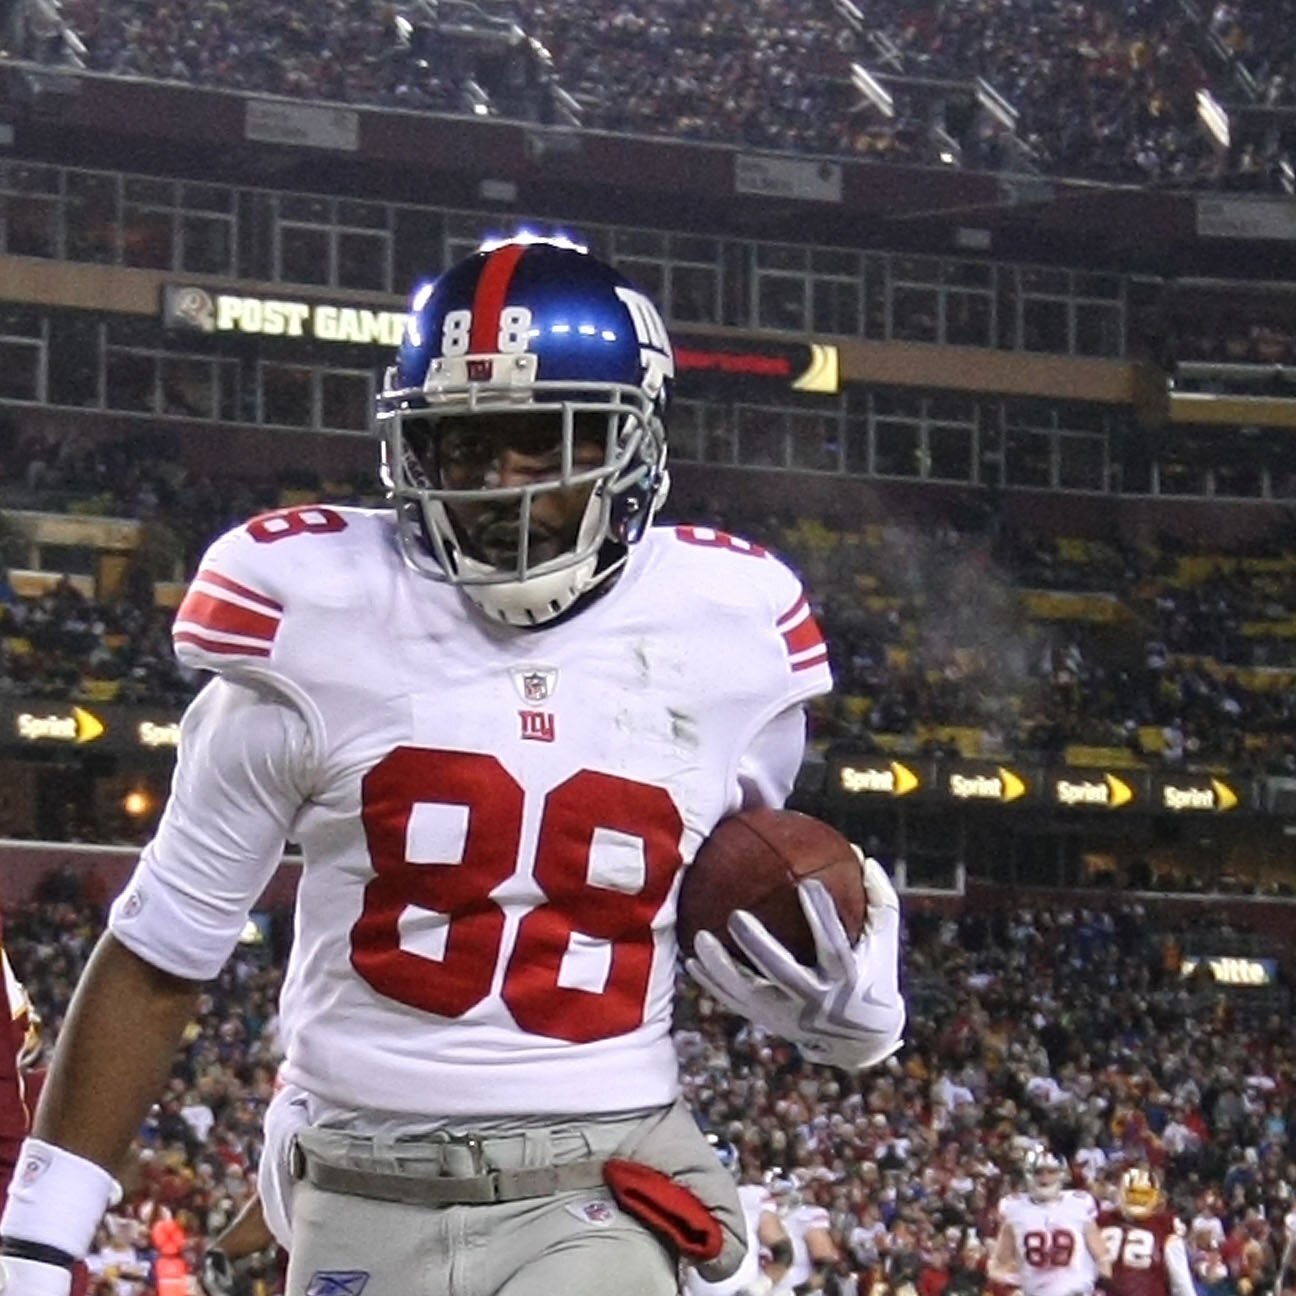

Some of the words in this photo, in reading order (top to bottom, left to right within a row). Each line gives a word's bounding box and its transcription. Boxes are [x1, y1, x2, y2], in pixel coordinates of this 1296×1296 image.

[217, 296, 308, 336] POST
[841, 767, 894, 793] Sprint
[950, 774, 1002, 799] Sprint
[1057, 779, 1108, 805] Sprint
[1163, 785, 1214, 810] Sprint
[350, 745, 684, 1043] 88
